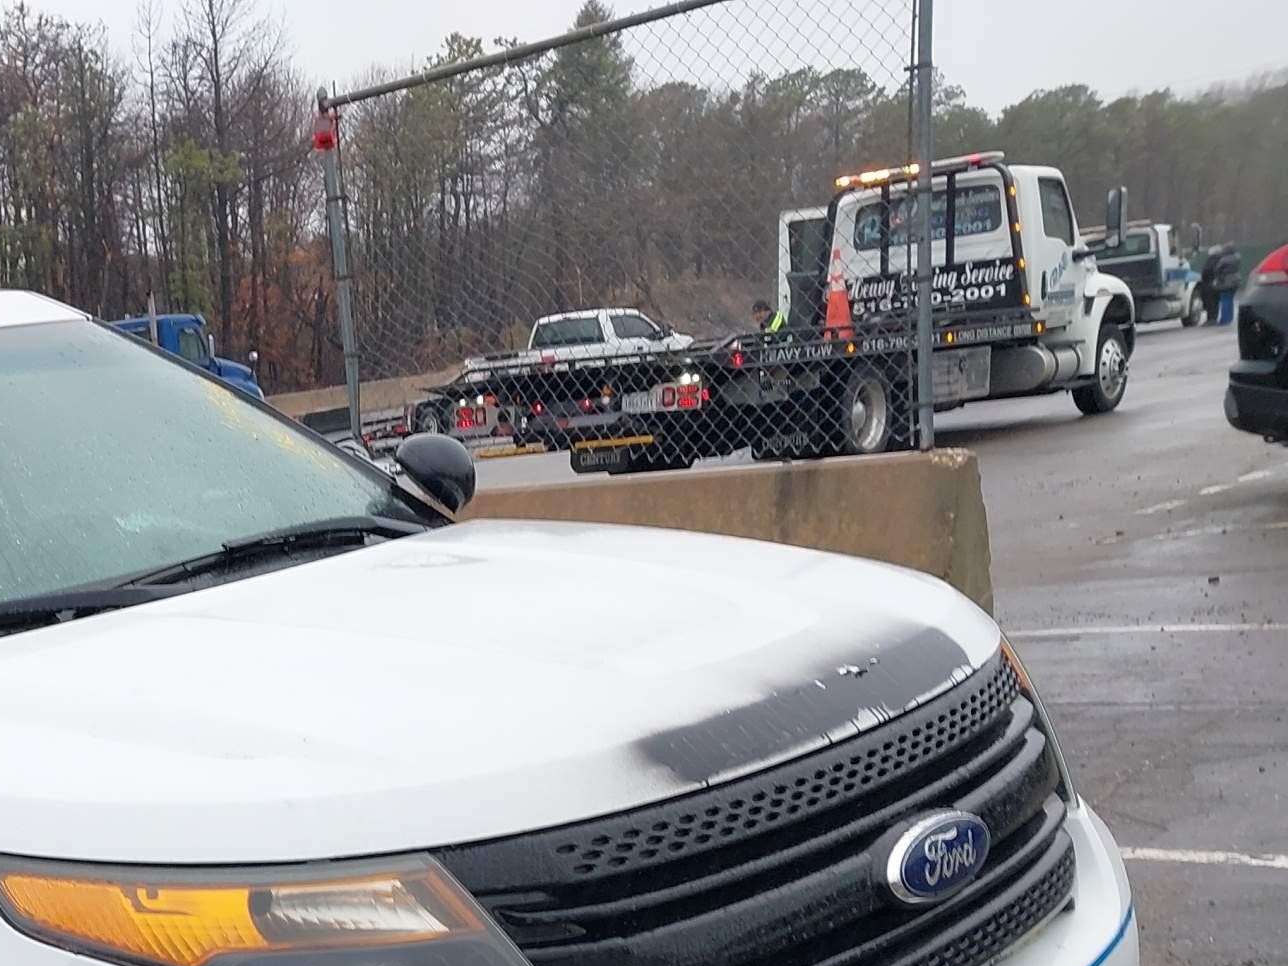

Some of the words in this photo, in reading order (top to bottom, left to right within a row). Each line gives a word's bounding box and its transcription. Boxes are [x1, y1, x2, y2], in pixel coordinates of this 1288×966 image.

[848, 278, 895, 302] Heavy
[961, 259, 1014, 285] Service
[759, 346, 801, 363] HEAVY
[806, 343, 833, 358] TOW
[924, 826, 977, 887] Ford
